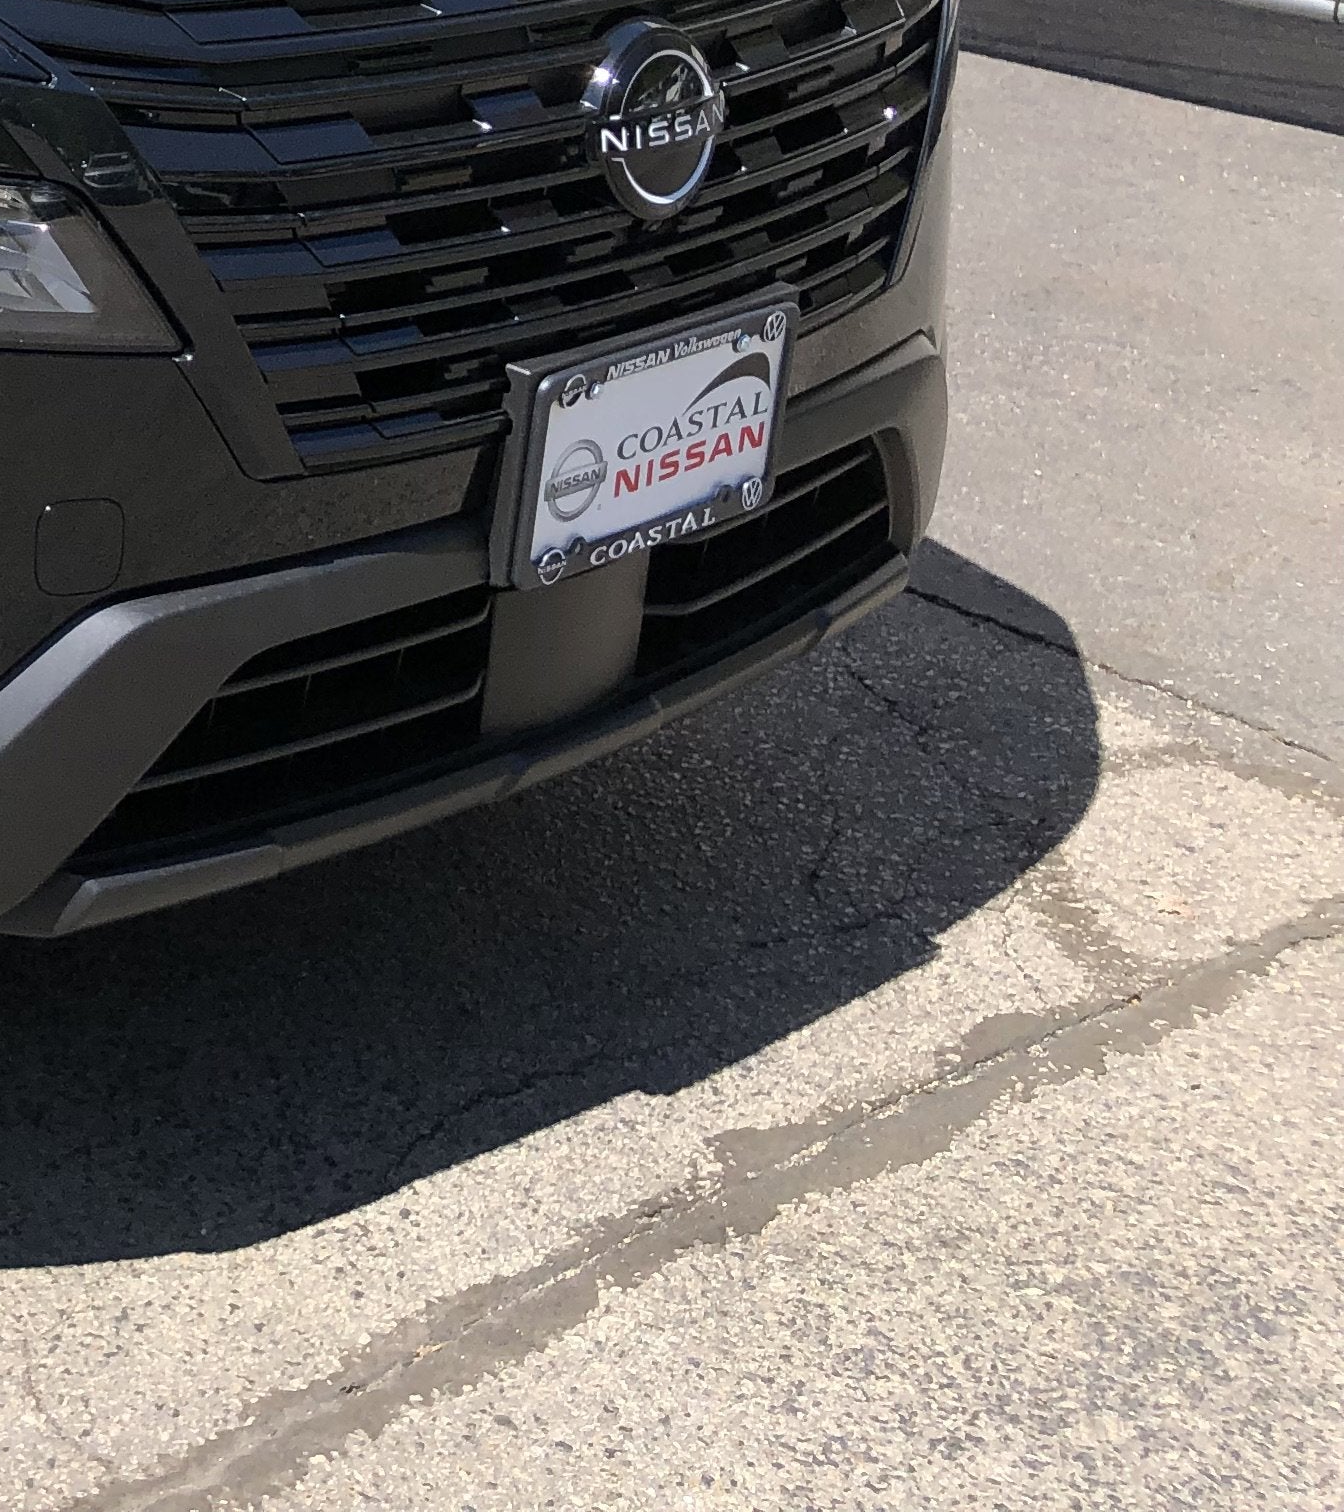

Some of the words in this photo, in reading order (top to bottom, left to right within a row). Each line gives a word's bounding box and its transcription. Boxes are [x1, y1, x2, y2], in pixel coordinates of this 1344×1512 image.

[601, 89, 725, 153] NISSAN
[606, 348, 671, 381] NISSAN
[674, 328, 742, 358] Volkswagen
[616, 391, 769, 460] COASTAL
[549, 467, 602, 495] NISSAN
[613, 421, 765, 498] NISSAN
[589, 507, 716, 565] COASTAL
